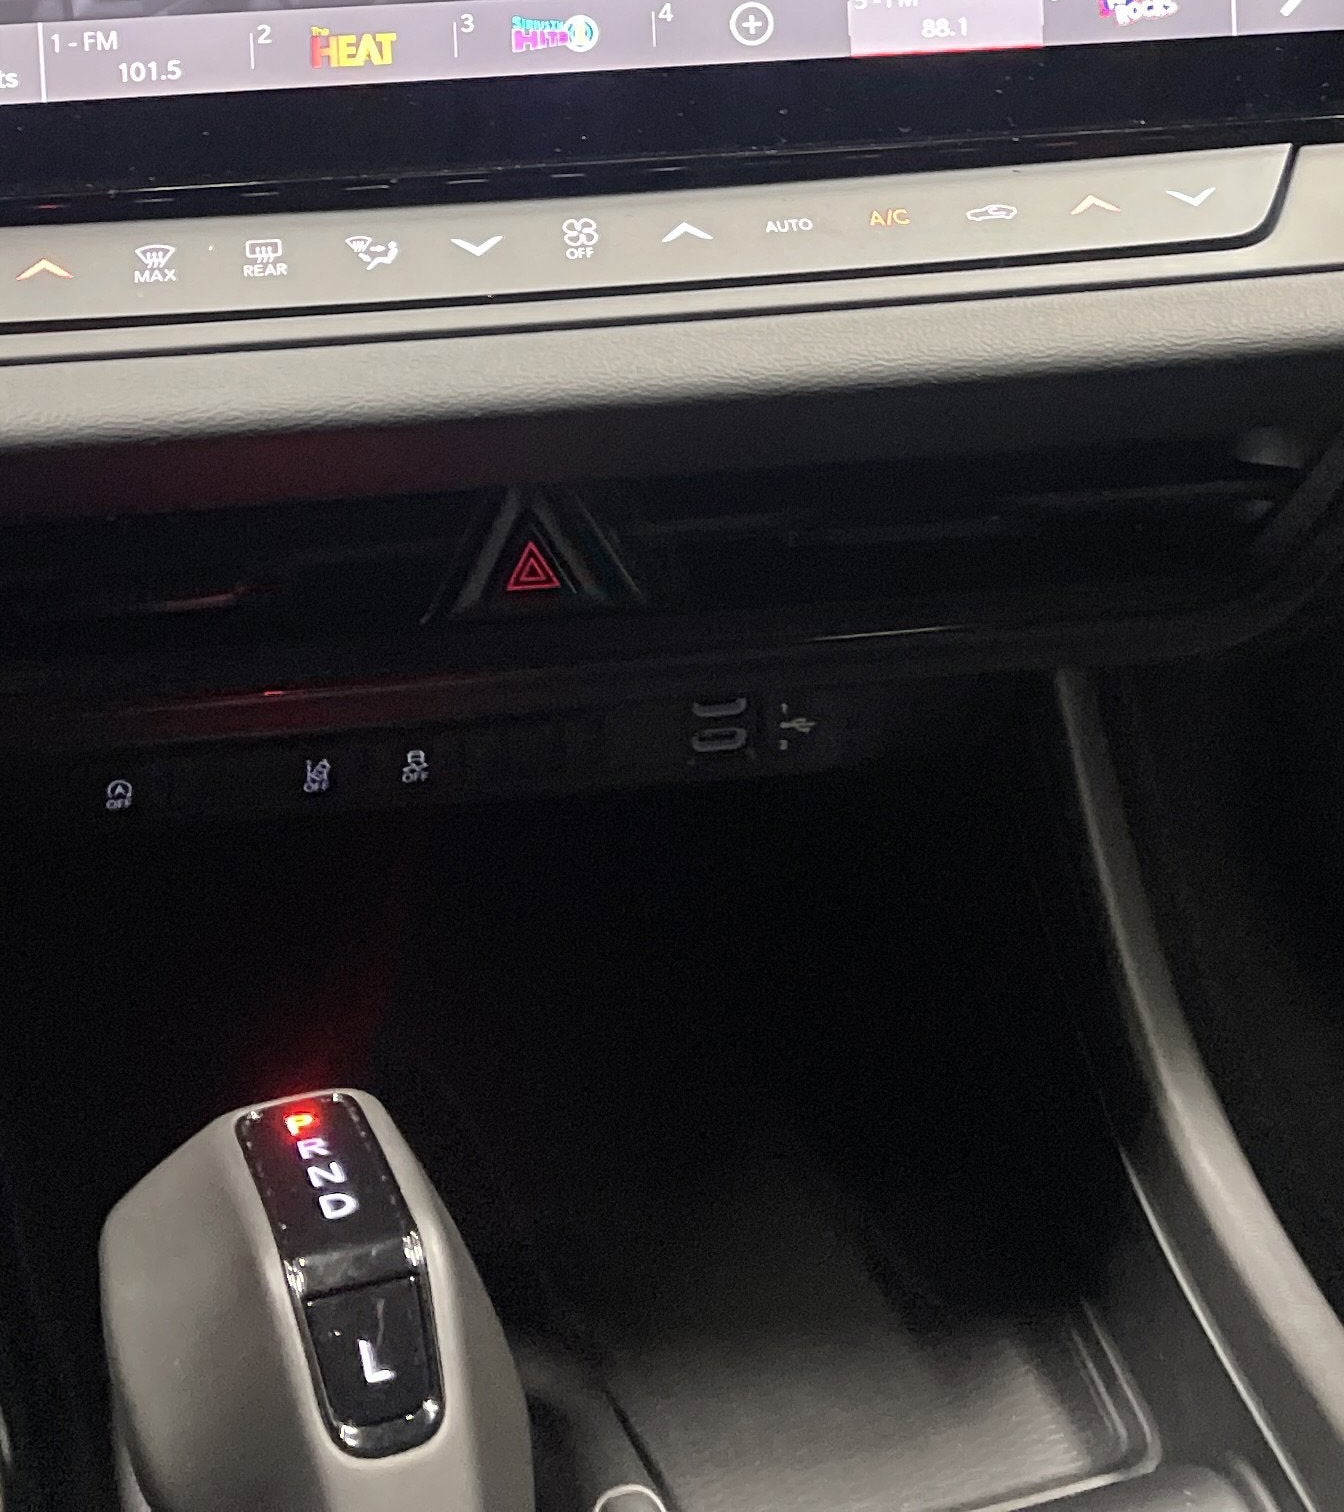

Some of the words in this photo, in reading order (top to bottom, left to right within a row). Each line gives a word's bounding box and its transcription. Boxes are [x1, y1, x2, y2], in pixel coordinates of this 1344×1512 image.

[459, 13, 475, 33] 3
[657, 2, 674, 23] 4
[256, 24, 273, 45] 2
[920, 16, 968, 38] 88.1
[50, 33, 61, 53] 1
[82, 30, 119, 52] FM
[310, 32, 397, 69] HEAT
[117, 59, 183, 84] 101.5
[765, 217, 814, 233] AUTO
[869, 207, 911, 227] A/C
[565, 246, 595, 261] OFF
[133, 268, 178, 284] MAX
[242, 262, 289, 278] REAR
[284, 1111, 317, 1136] P
[296, 1137, 330, 1159] R
[306, 1161, 347, 1188] N
[317, 1192, 359, 1220] D
[356, 1338, 396, 1384] L
